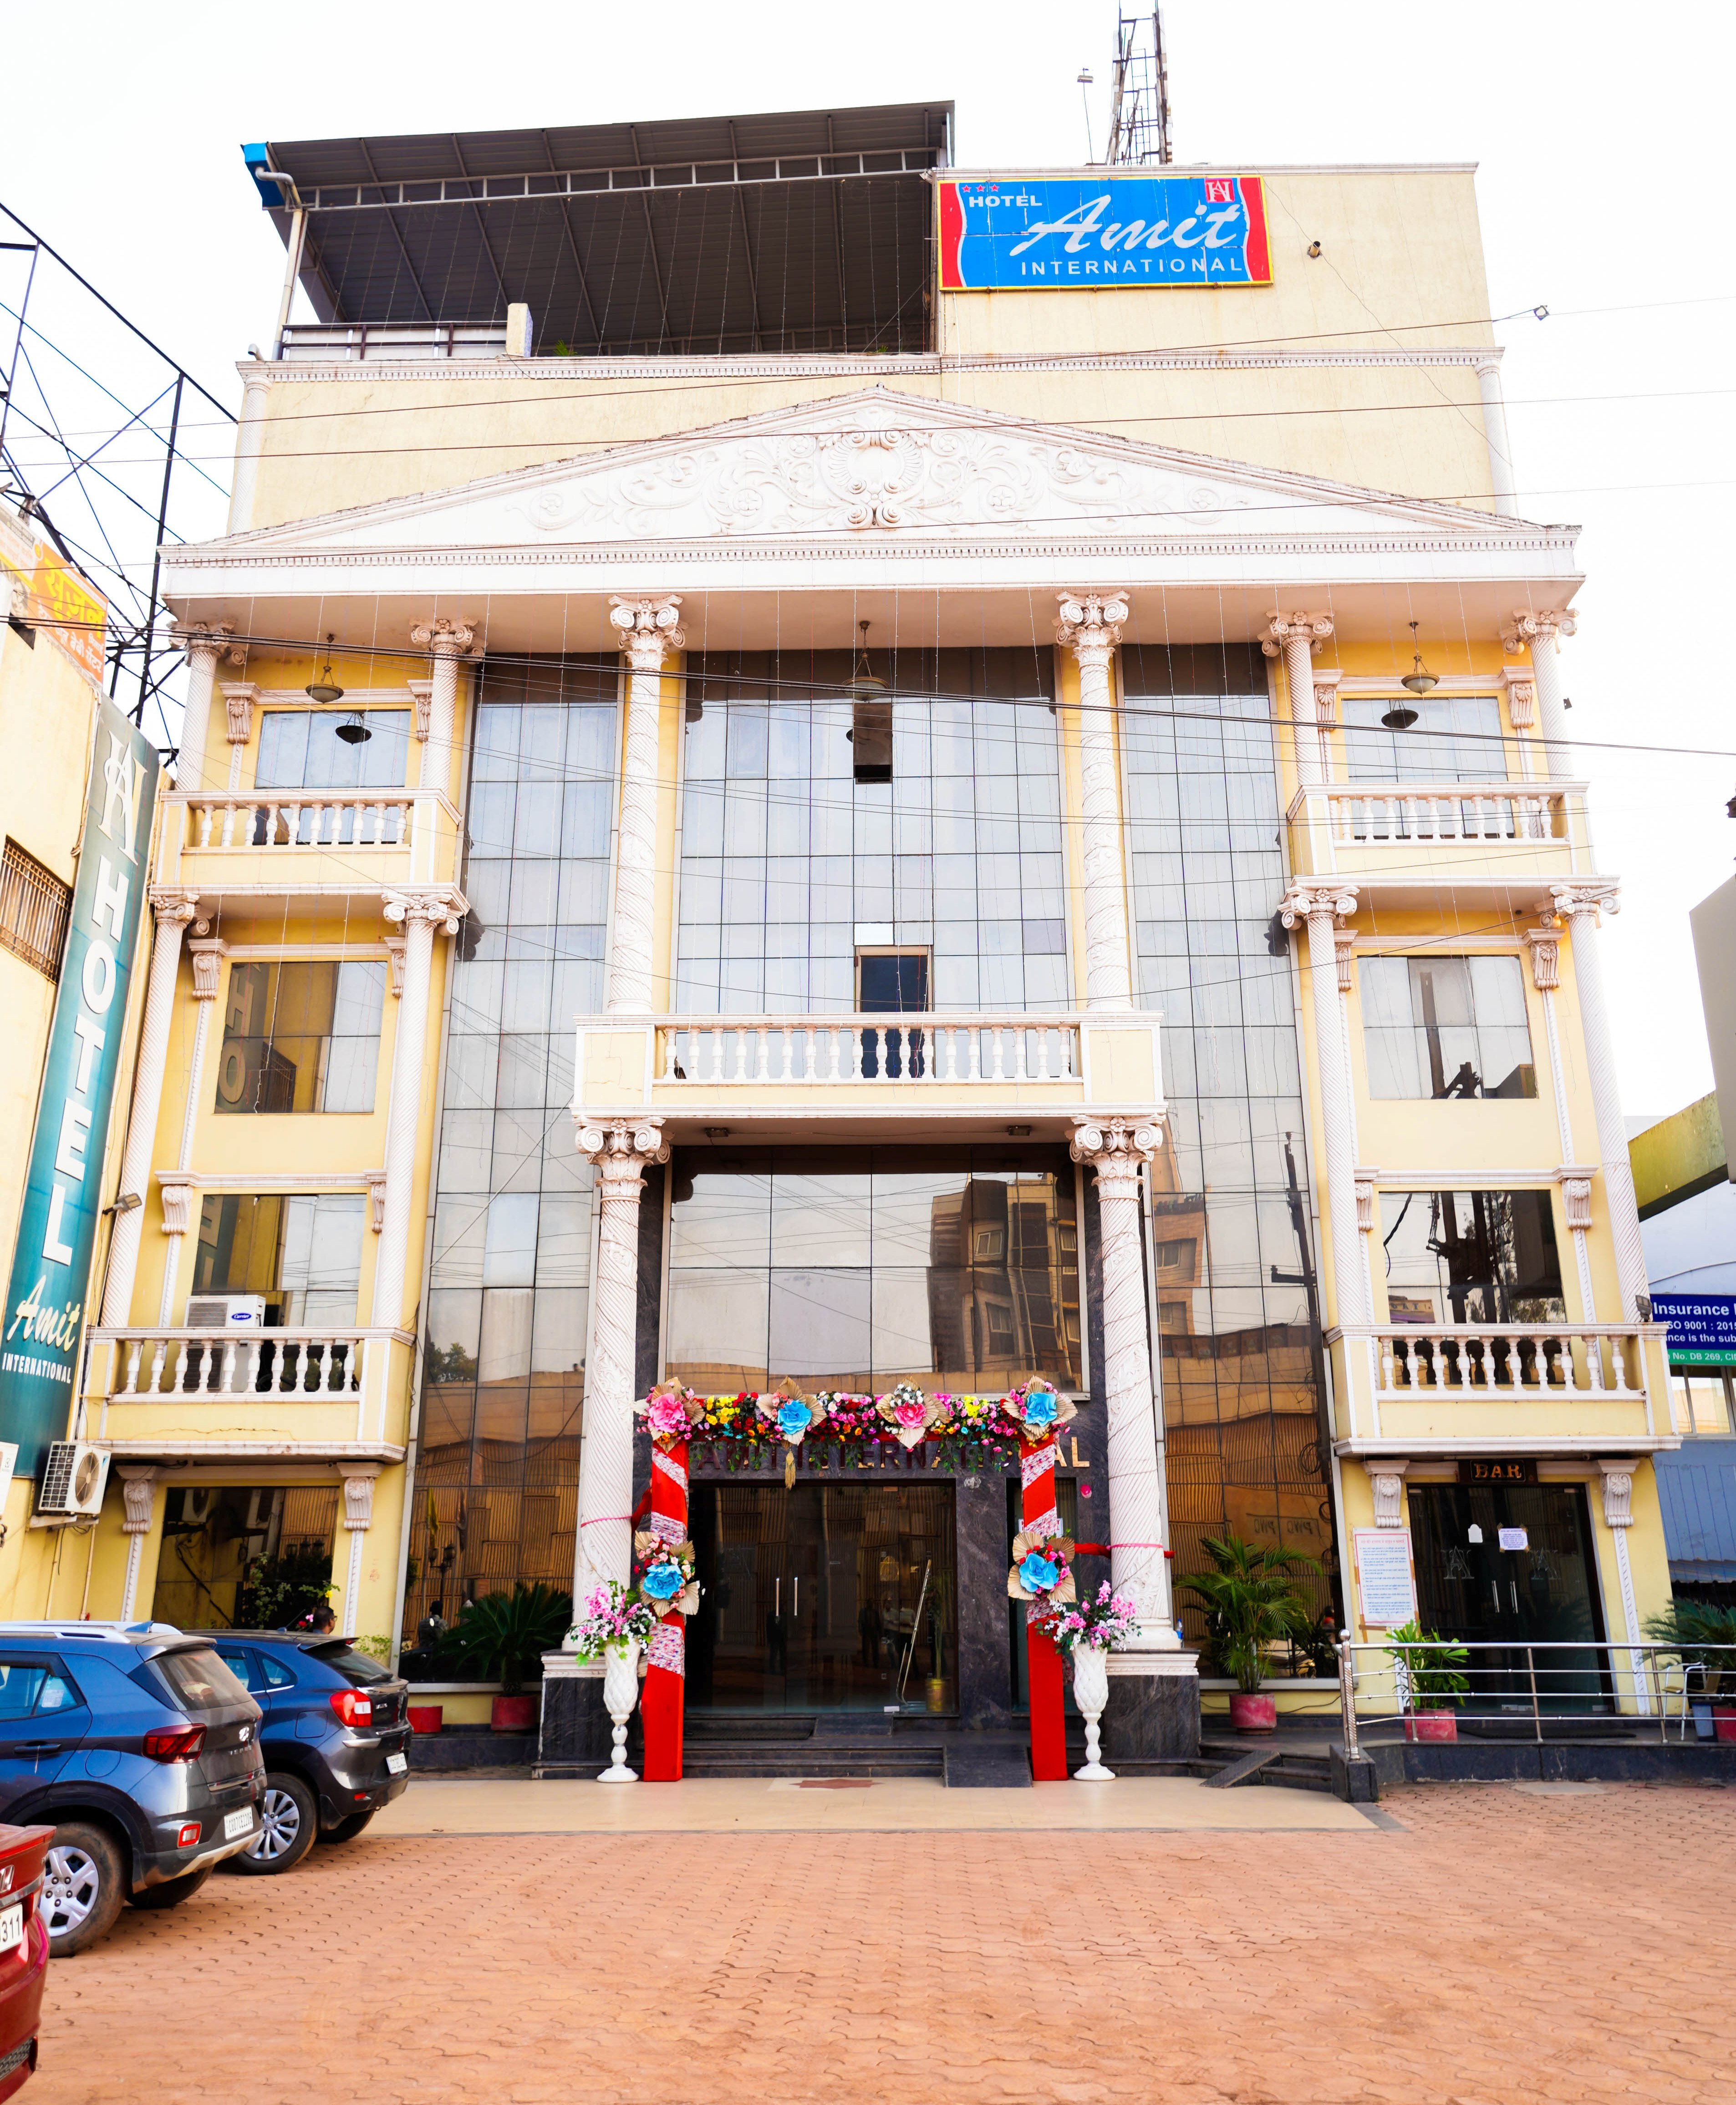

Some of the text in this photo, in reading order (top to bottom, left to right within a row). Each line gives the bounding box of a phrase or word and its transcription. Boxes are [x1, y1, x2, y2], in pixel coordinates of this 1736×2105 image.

[969, 195, 1043, 208] HOTEL
[1010, 194, 1240, 256] Amit
[1022, 258, 1243, 275] INTERNATIONAL
[42, 855, 129, 1267] HOTEL
[7, 1275, 81, 1352] Amit
[1653, 1302, 1730, 1315] Insurance
[1668, 1320, 1682, 1330] SO
[1684, 1321, 1706, 1330] 9001
[1688, 1333, 1697, 1342] is
[1700, 1334, 1716, 1342] the
[1690, 1352, 1702, 1361] DB
[2, 1352, 71, 1384] INTERNATIONAL
[1474, 1463, 1522, 1478] BAR
